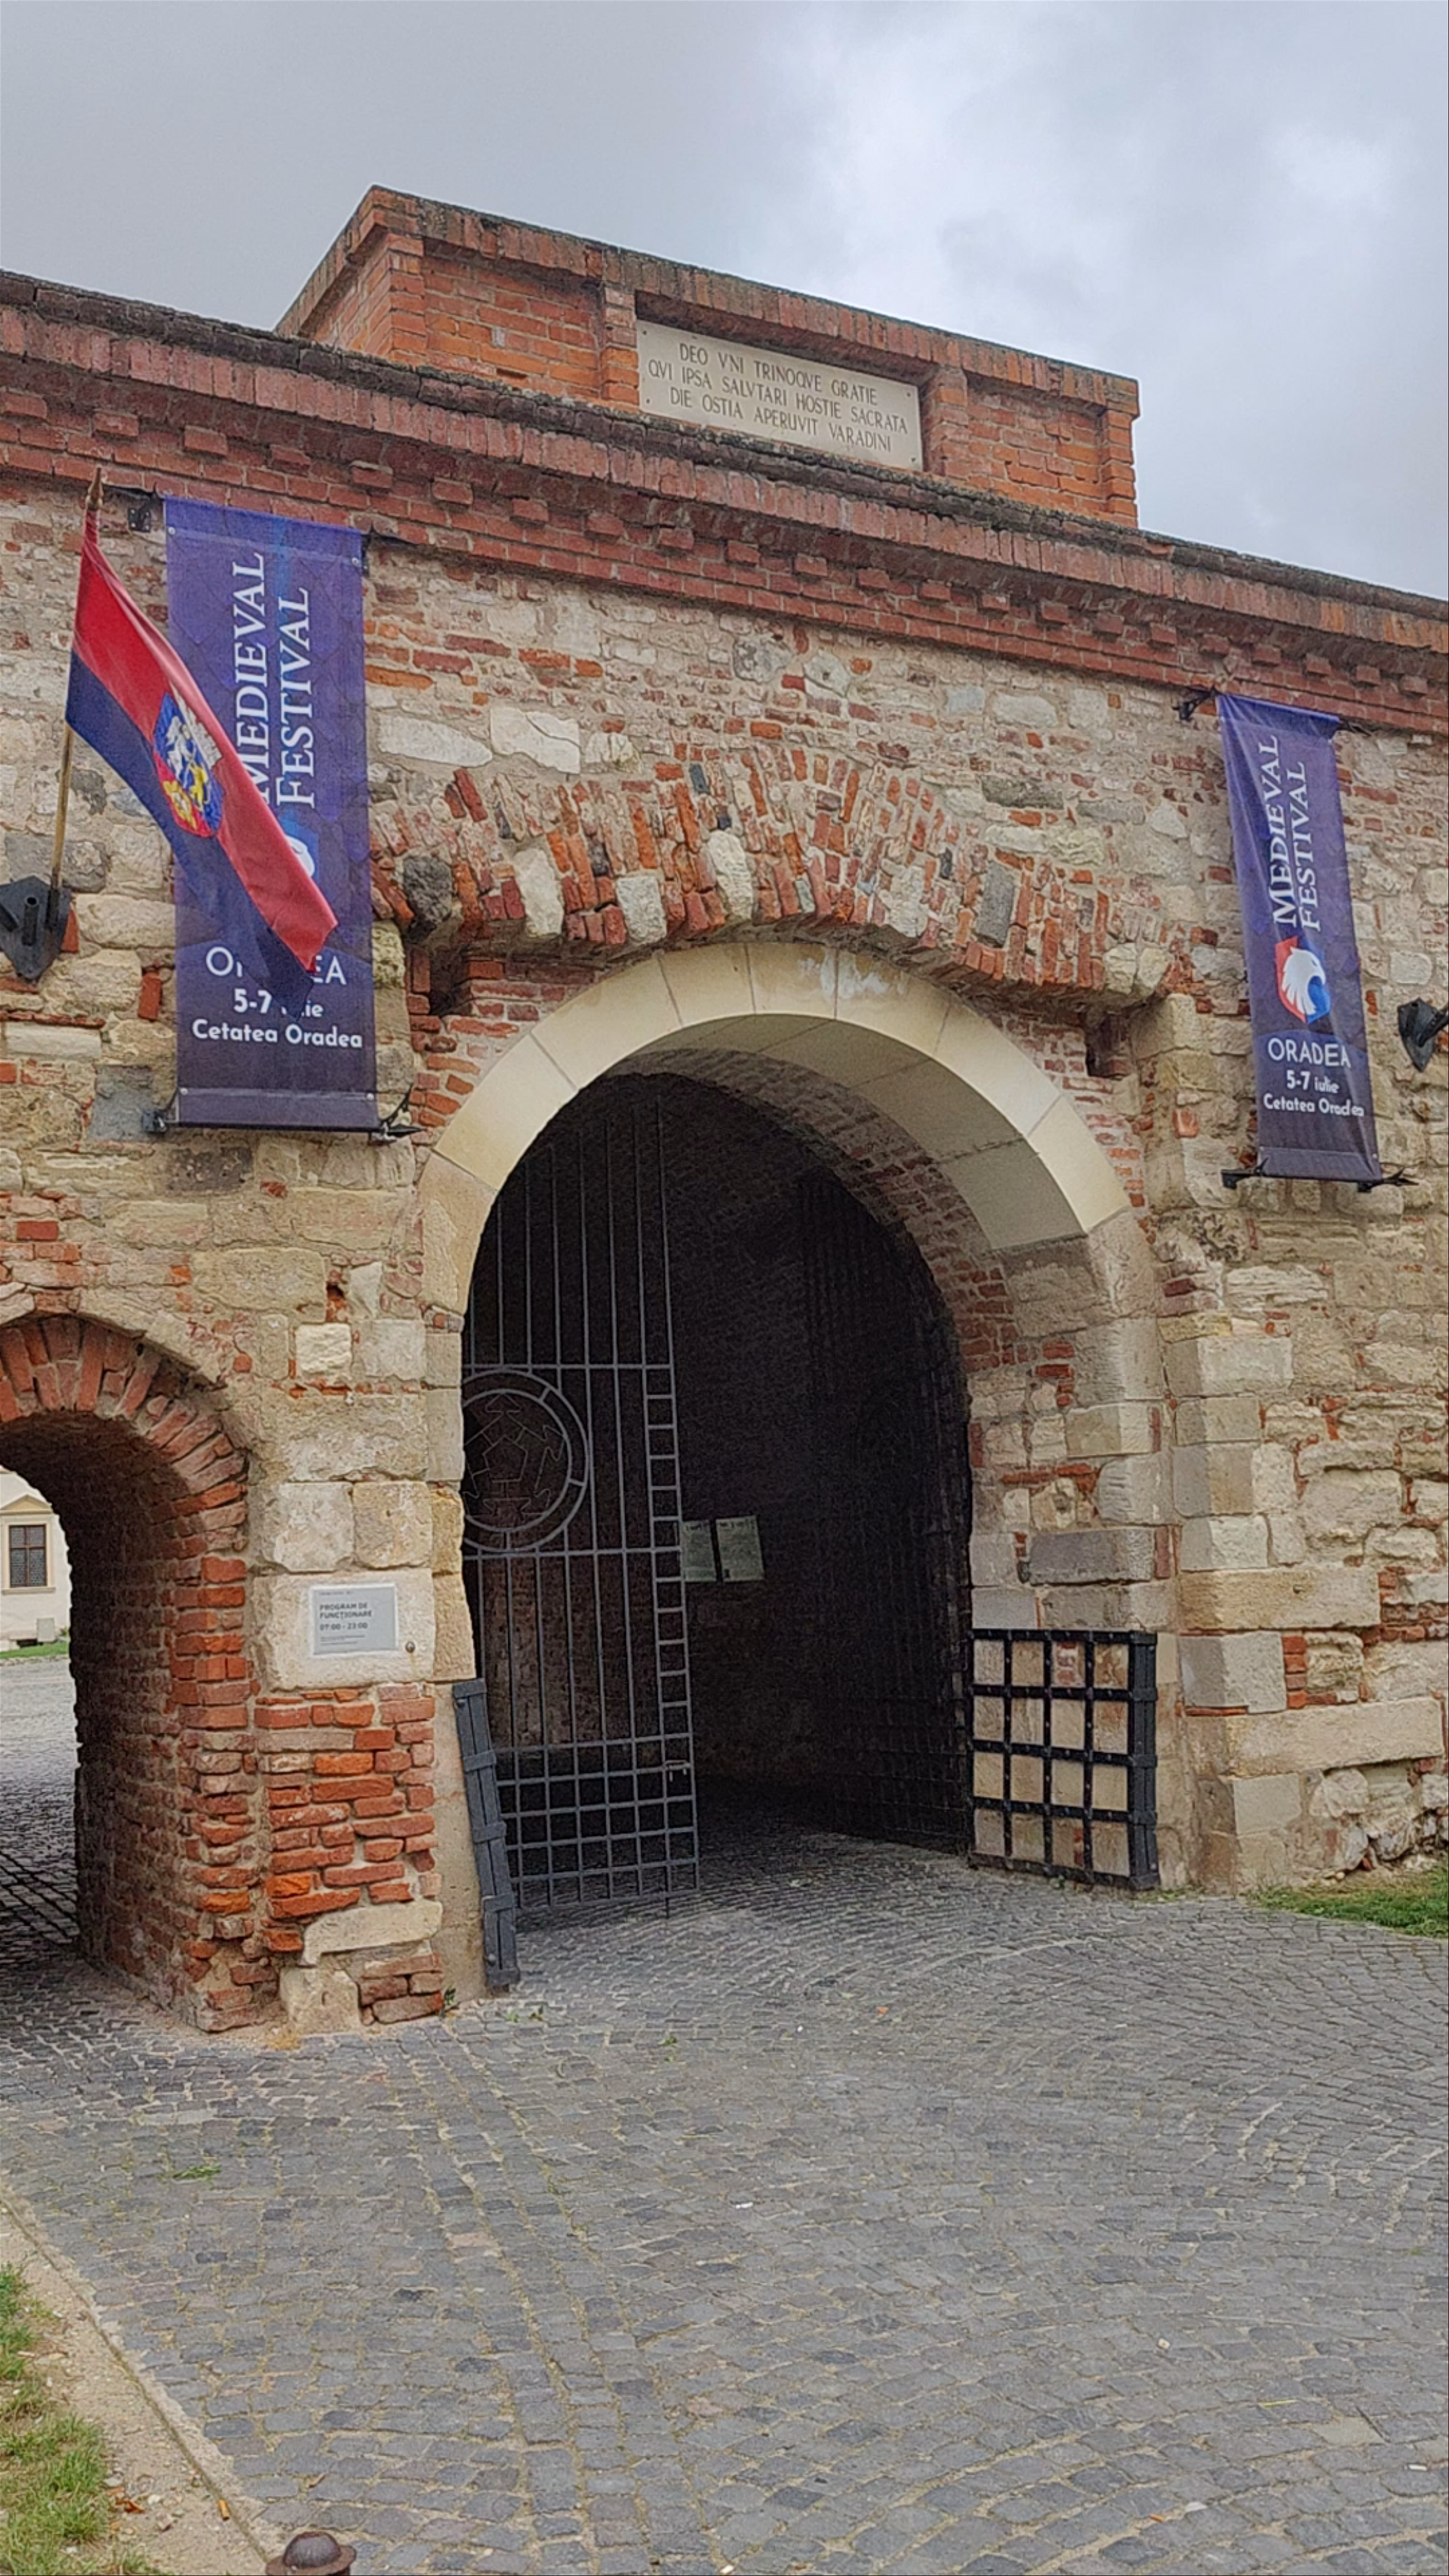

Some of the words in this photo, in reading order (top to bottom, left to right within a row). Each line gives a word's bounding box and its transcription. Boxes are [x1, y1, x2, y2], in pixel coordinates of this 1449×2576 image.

[648, 359, 672, 380] QVI
[682, 366, 712, 390] IPSA
[722, 376, 787, 406] SALVTARI
[796, 392, 842, 419] HOSTIE
[851, 406, 908, 434] SACRATA
[680, 343, 708, 366] DEO
[718, 352, 744, 374] VNI
[754, 360, 822, 392] TRINOQVE
[831, 379, 878, 406] GRATIE
[670, 387, 692, 408] DIE
[702, 394, 743, 419] OSTIA
[829, 423, 891, 452] VARADINI
[275, 587, 315, 809] FESTIVAL
[1258, 734, 1297, 927] MEDIEVAL
[1286, 761, 1320, 932] FESTIVAL
[234, 988, 272, 1013] 5-7
[192, 1018, 278, 1043] Cetatea
[285, 1024, 363, 1047] Oradea
[1268, 1038, 1351, 1068] ORADEA
[1263, 1093, 1315, 1112] Cetatea
[1318, 1098, 1364, 1117] Oradea
[1286, 1069, 1311, 1090] 5-7
